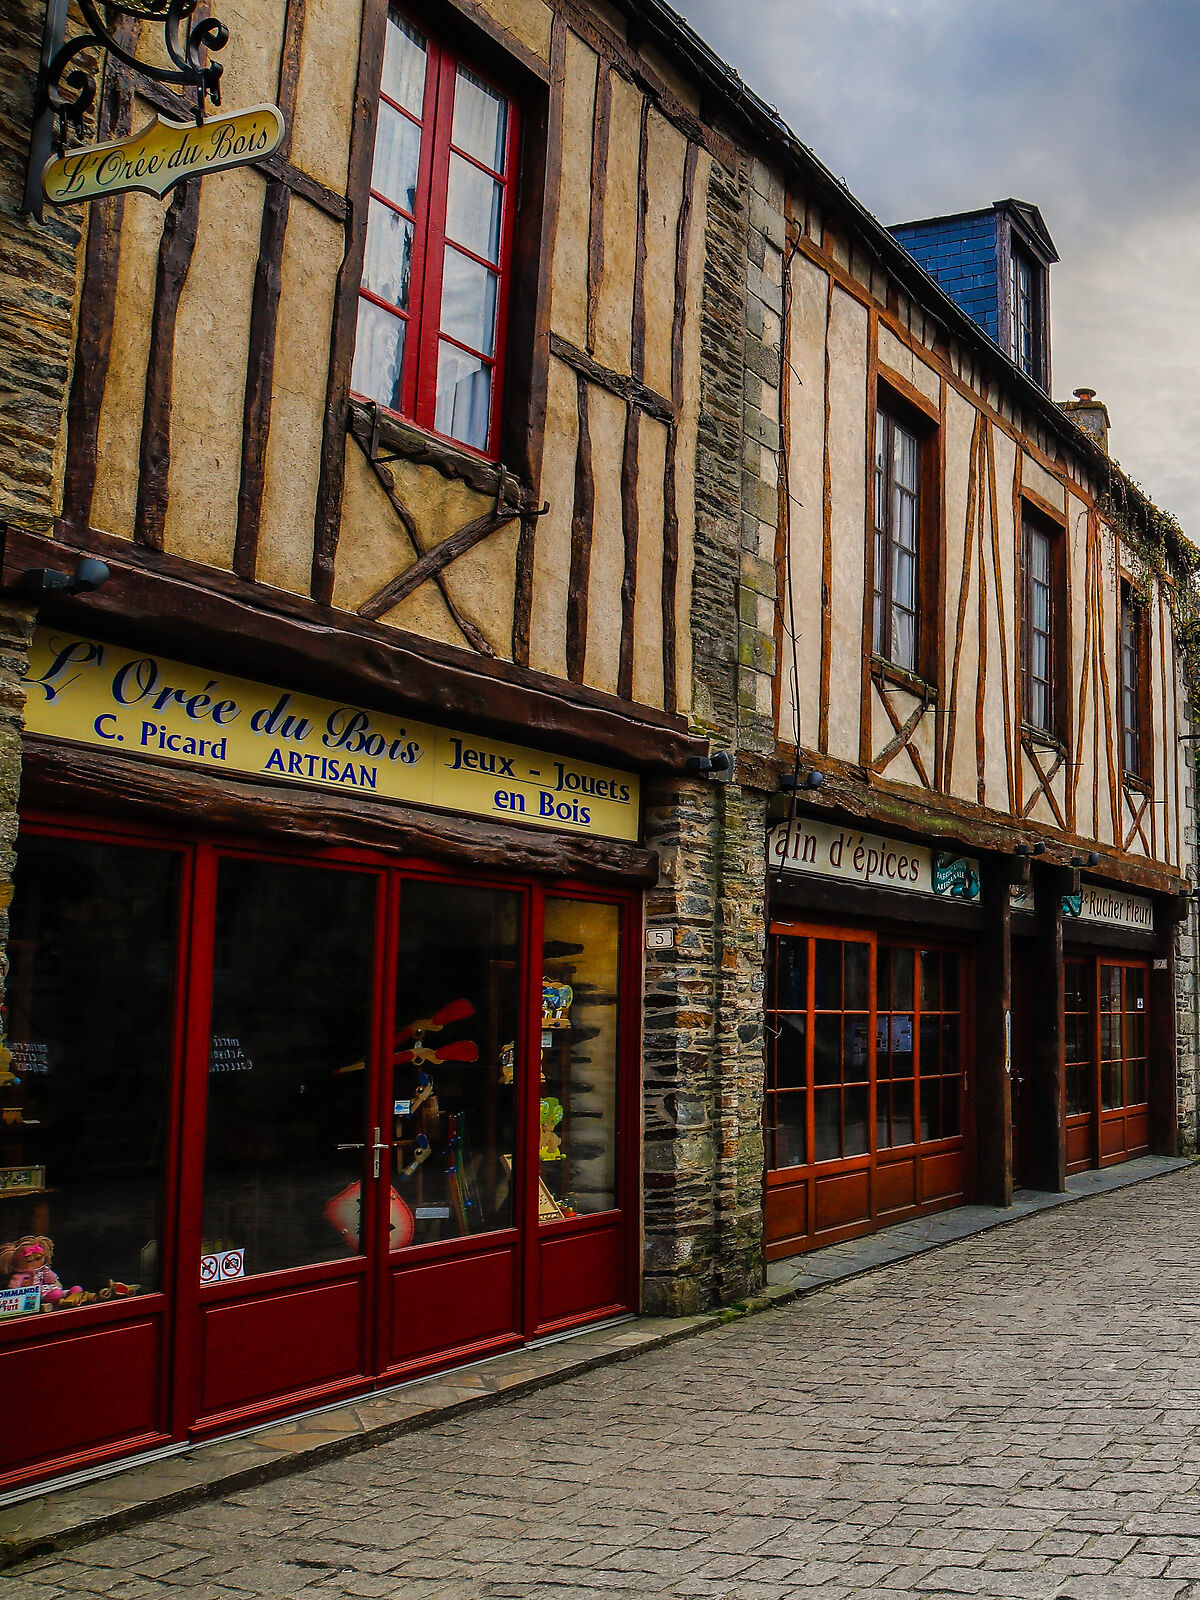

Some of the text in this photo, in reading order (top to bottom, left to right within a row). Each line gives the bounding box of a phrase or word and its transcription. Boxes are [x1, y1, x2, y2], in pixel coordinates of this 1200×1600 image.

[56, 122, 268, 196] L'Orée du Bois
[93, 713, 228, 761] C. Picard
[250, 693, 316, 742] du
[322, 706, 425, 766] Bois
[264, 748, 378, 789] ARTISAN
[447, 737, 517, 778] Jeux
[552, 761, 631, 802] Jouets
[493, 788, 592, 825] en Bois
[829, 832, 920, 882] d'épices
[1089, 890, 1124, 920] Rucher
[1125, 898, 1152, 925] Fleuri
[655, 932, 664, 945] 5
